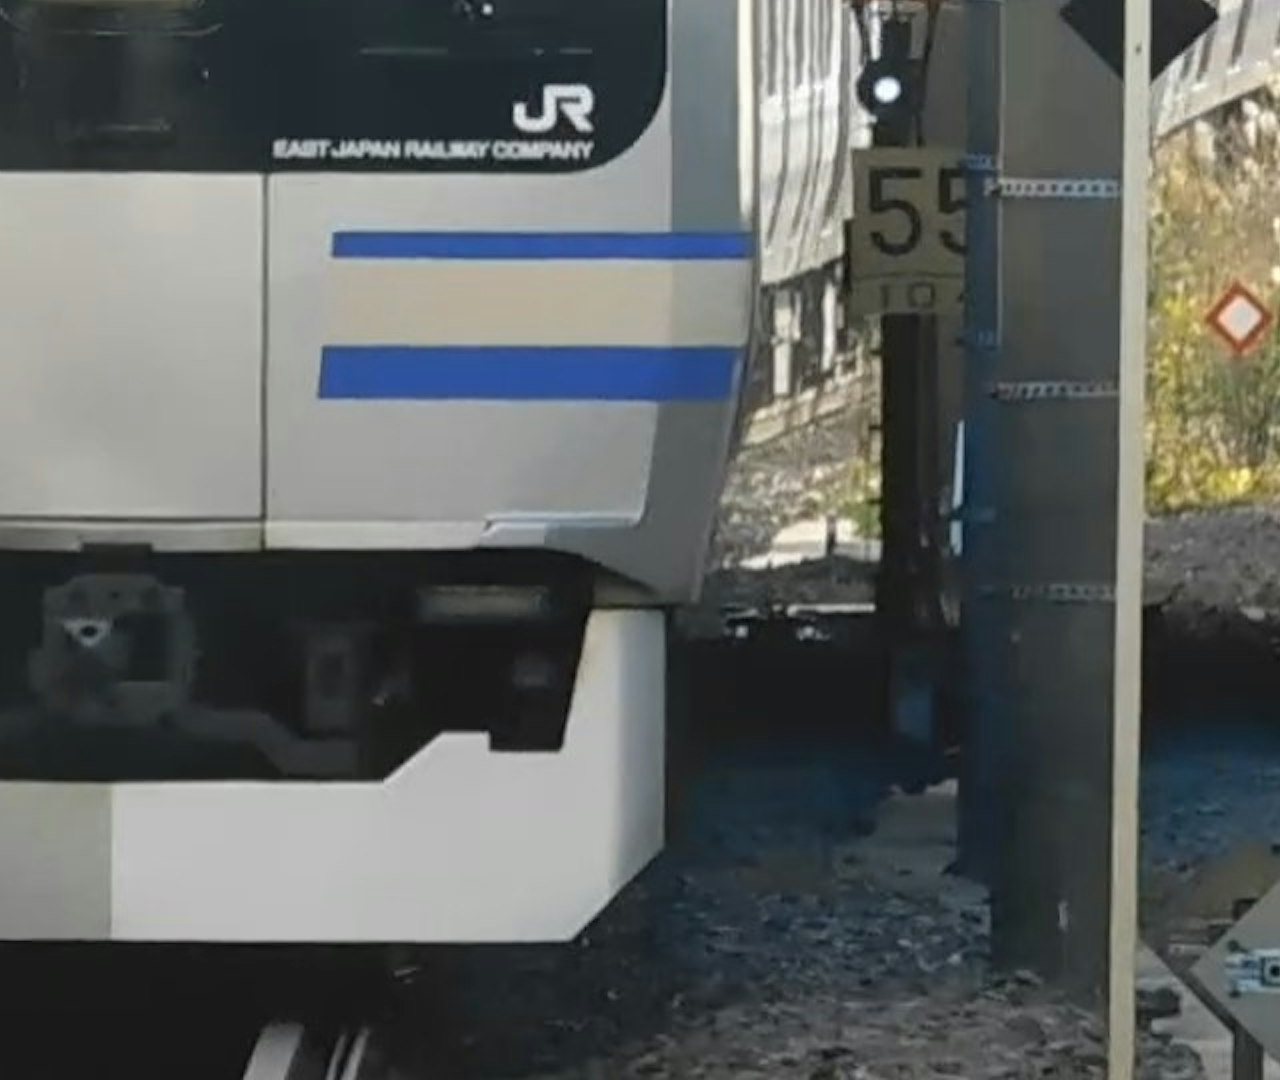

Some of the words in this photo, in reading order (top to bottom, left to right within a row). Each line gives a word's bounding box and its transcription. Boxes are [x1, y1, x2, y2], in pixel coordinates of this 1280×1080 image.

[512, 84, 594, 132] JR
[272, 139, 332, 159] EAST
[332, 139, 402, 159] JAPAN
[404, 139, 489, 159] RAILWAY
[491, 139, 595, 160] COMPANY
